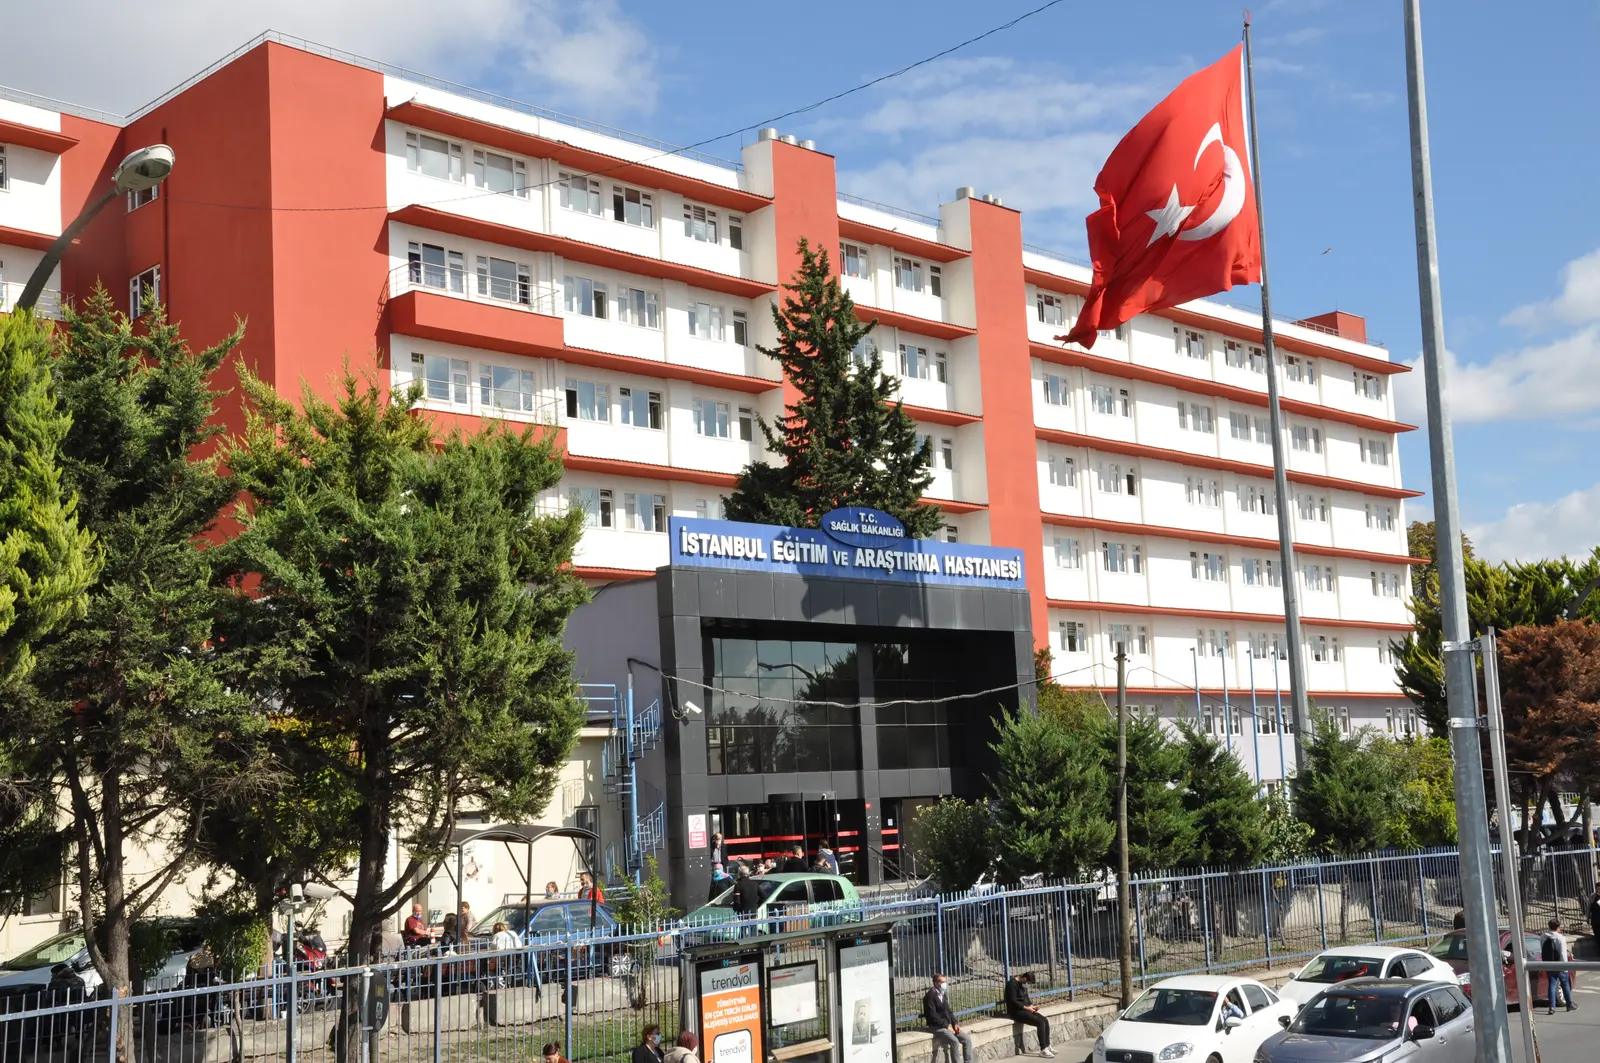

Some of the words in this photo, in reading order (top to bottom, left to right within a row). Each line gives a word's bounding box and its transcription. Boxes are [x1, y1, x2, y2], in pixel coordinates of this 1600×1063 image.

[859, 512, 878, 524] T.C.
[830, 519, 860, 535] SAĞLIK
[861, 523, 904, 538] BAKANLIĞI
[681, 526, 767, 559] İSTANBUL
[772, 535, 828, 565] EĞİTİM
[832, 550, 849, 566] VE
[854, 547, 940, 574] ARAŞTIRMA
[944, 556, 1022, 579] HASTANESİ
[711, 972, 752, 991] trendyol
[719, 1044, 747, 1057] trendyol
